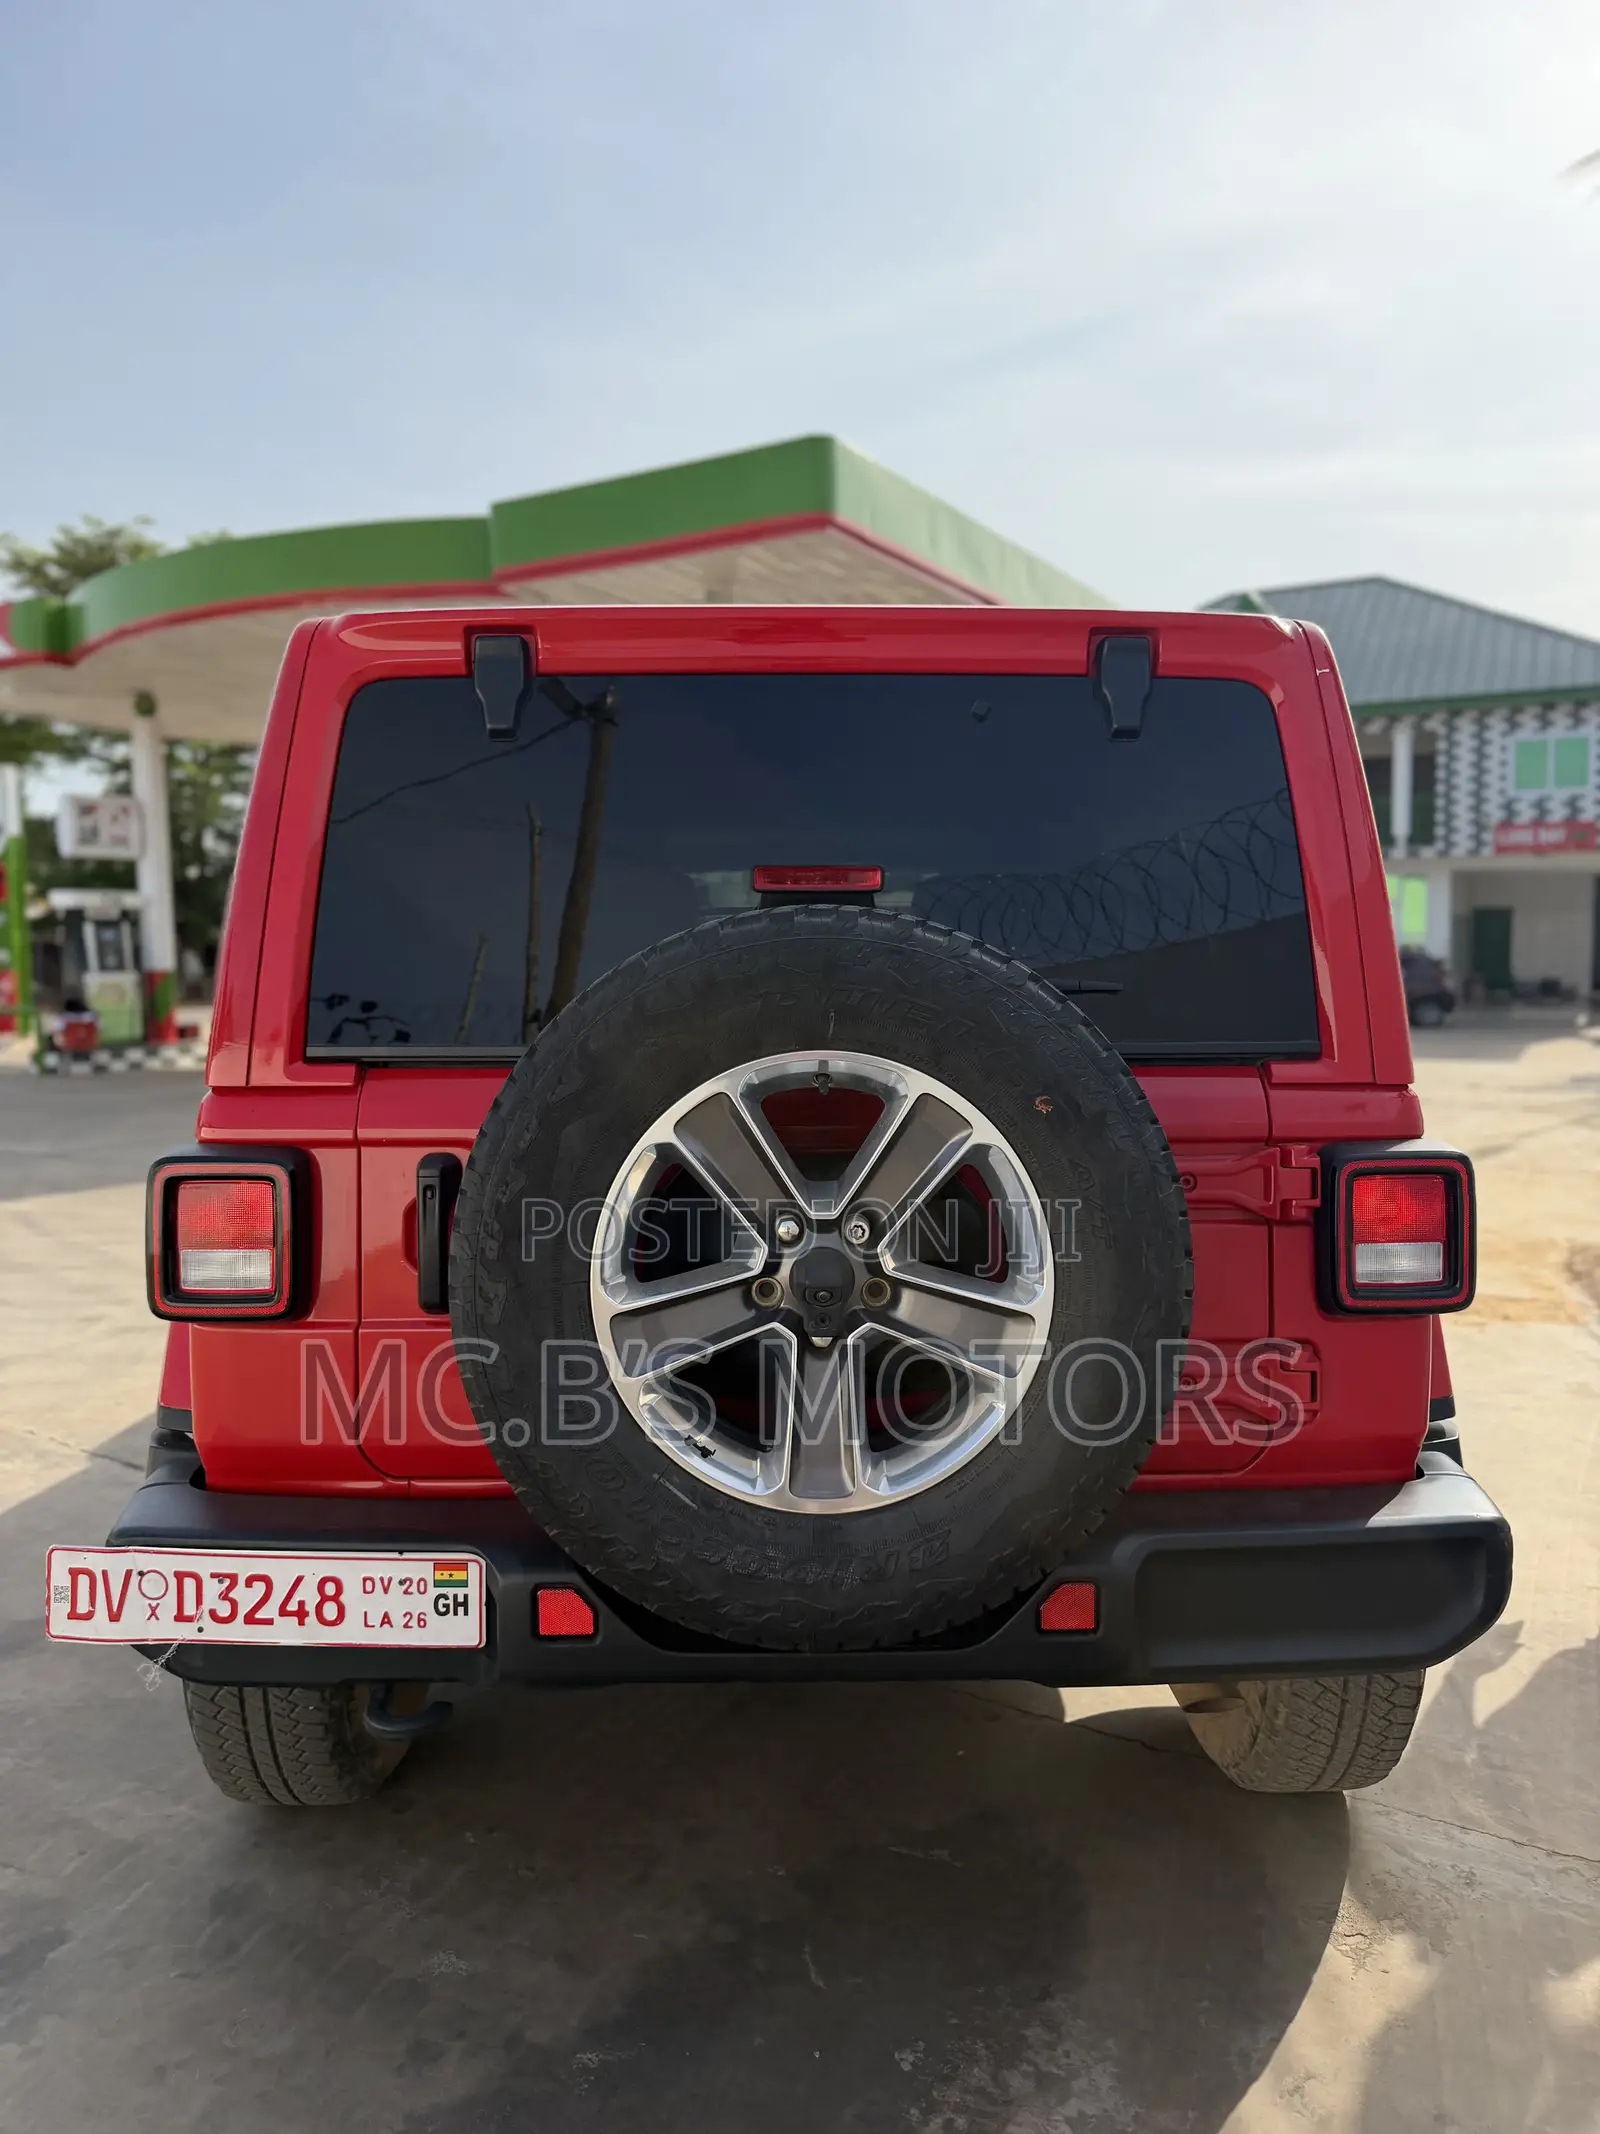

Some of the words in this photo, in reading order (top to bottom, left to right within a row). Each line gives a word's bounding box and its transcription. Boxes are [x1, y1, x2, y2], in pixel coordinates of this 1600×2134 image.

[361, 1576, 393, 1595] DV
[401, 1577, 428, 1595] 20
[67, 1567, 133, 1622] DV
[173, 1570, 346, 1627] D3248
[433, 1593, 469, 1617] GH
[363, 1611, 394, 1629] LA
[401, 1611, 428, 1629] 26
